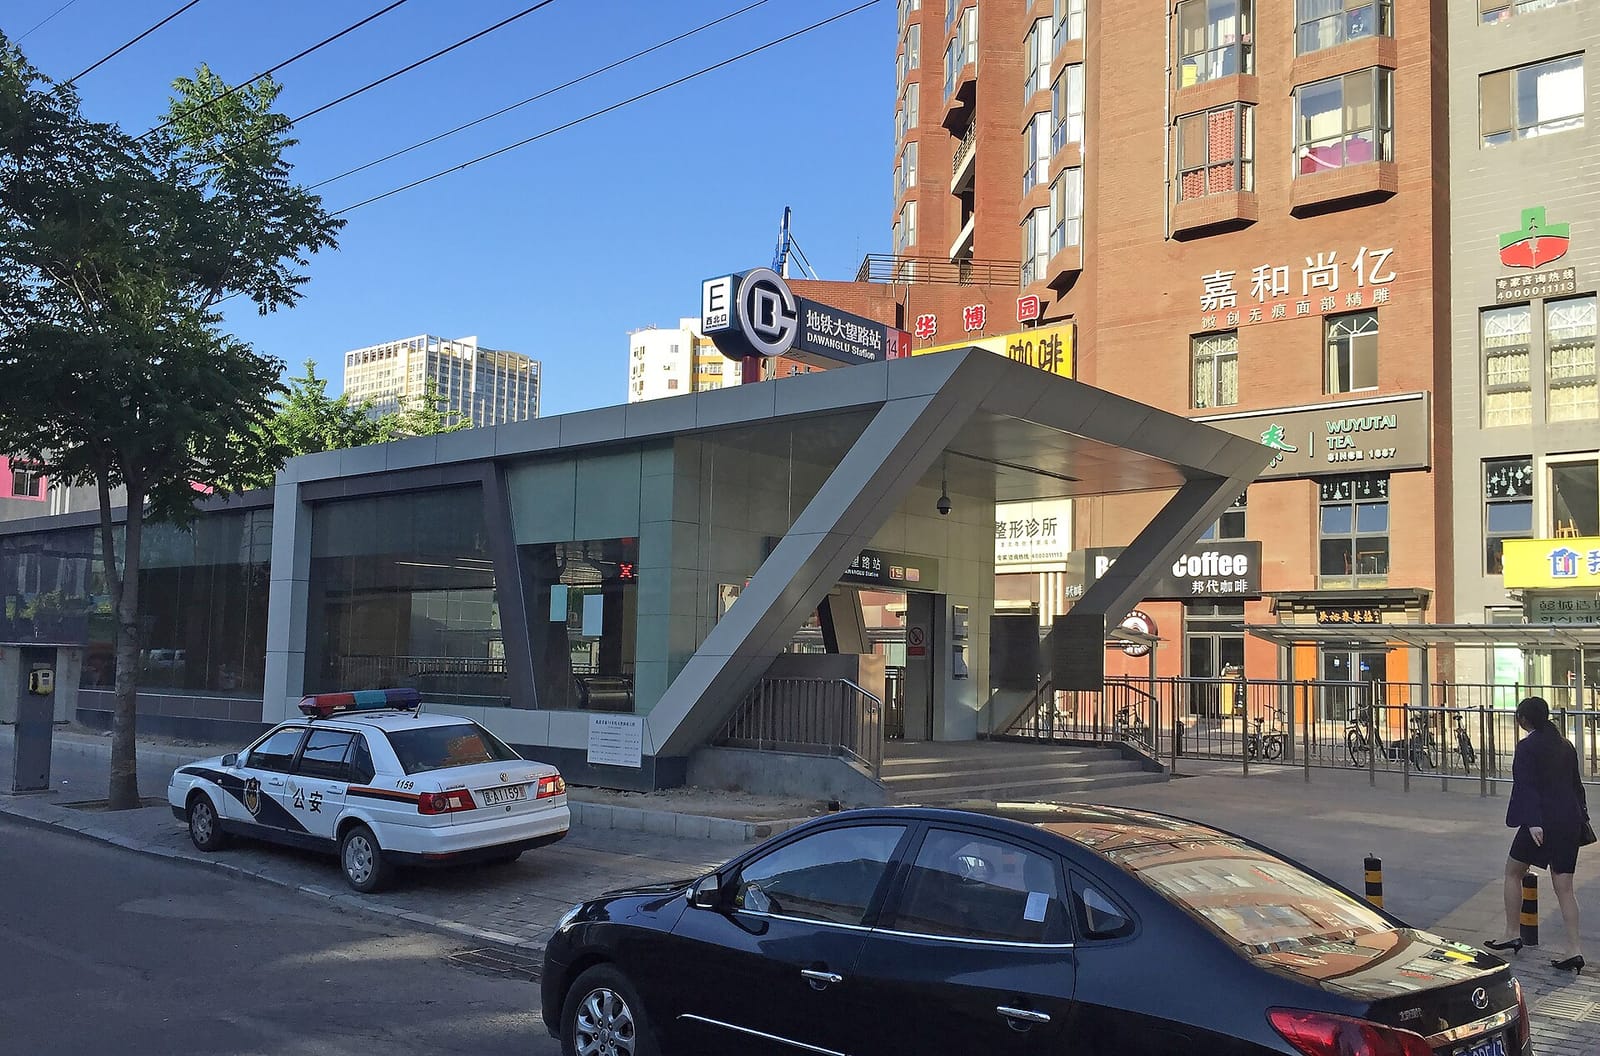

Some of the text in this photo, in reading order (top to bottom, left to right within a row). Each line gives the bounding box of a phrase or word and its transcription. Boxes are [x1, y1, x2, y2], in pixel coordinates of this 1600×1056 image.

[1200, 247, 1397, 312] 嘉和尚亿
[1497, 269, 1575, 290] 专家咨询热线
[709, 283, 724, 312] E
[1497, 282, 1575, 300] 4000011113
[706, 314, 727, 326] 西北口
[916, 296, 1040, 339] 华博园
[806, 309, 881, 351] 地铁大望路站
[807, 332, 875, 360] DAWANGLU Station
[887, 338, 898, 356] 14
[902, 343, 908, 358] 1
[1326, 415, 1397, 434] WUYUTAI
[1327, 435, 1356, 450] TEA
[1327, 450, 1364, 462] SINCE
[995, 517, 1058, 540] 整形诊所
[1171, 551, 1249, 578] Coffee
[1191, 578, 1249, 595] 邦代咖啡
[396, 780, 415, 790] 1159
[292, 787, 323, 813] 公安
